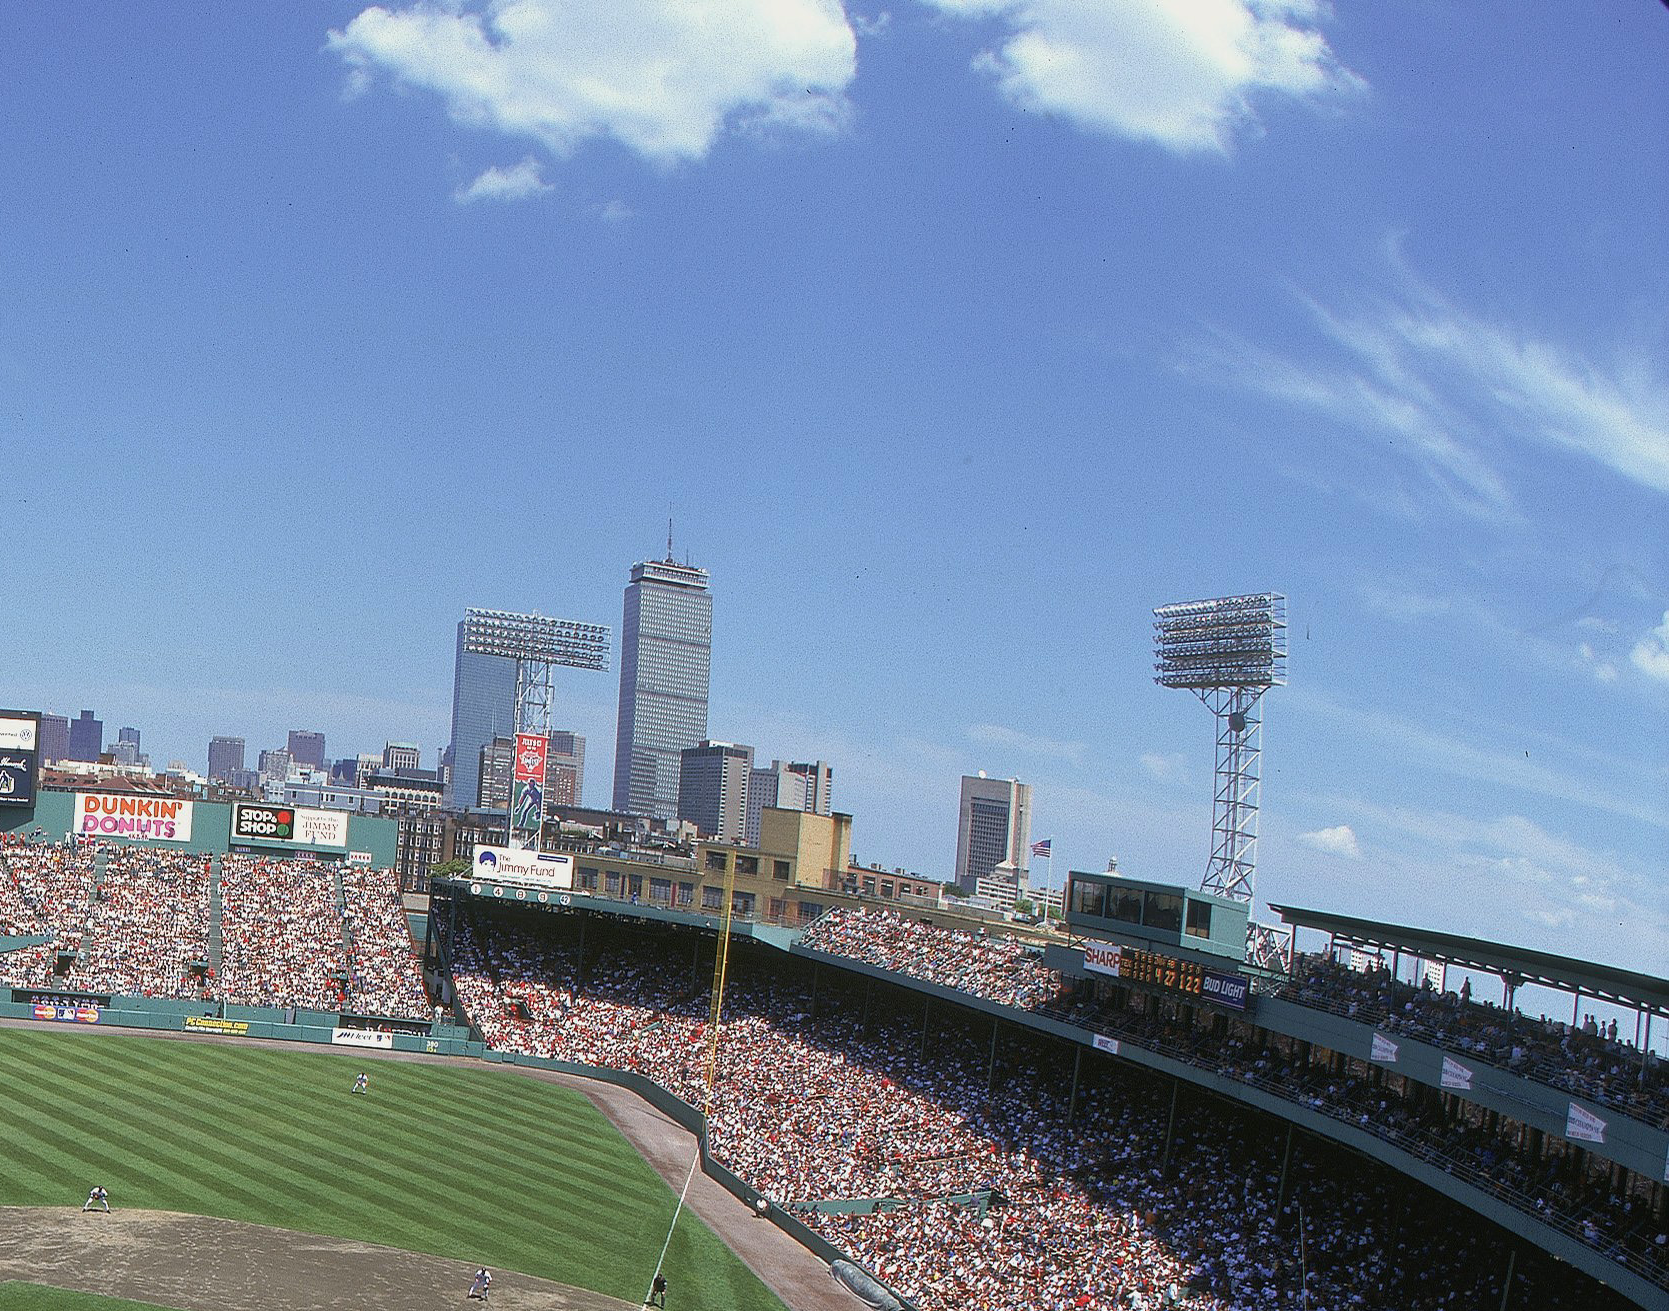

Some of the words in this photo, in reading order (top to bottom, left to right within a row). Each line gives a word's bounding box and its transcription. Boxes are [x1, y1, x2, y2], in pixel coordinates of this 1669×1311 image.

[84, 795, 183, 819] DUNKIN'
[83, 814, 176, 838] DONUTS
[239, 821, 276, 834] SHOP
[302, 821, 338, 832] JIMMY
[499, 854, 511, 862] The
[497, 862, 529, 876] Jimmy
[530, 865, 555, 877] Fund
[495, 888, 501, 896] 4
[518, 890, 524, 898] 8
[561, 896, 569, 904] 42
[1085, 947, 1121, 968] SHARP
[1155, 967, 1162, 984] 4
[1164, 970, 1176, 987] 27
[1179, 974, 1185, 990] 1
[1185, 975, 1193, 992] 2
[1193, 977, 1201, 994] 2
[1203, 976, 1220, 993] BUD
[1221, 980, 1245, 999] LIGHT
